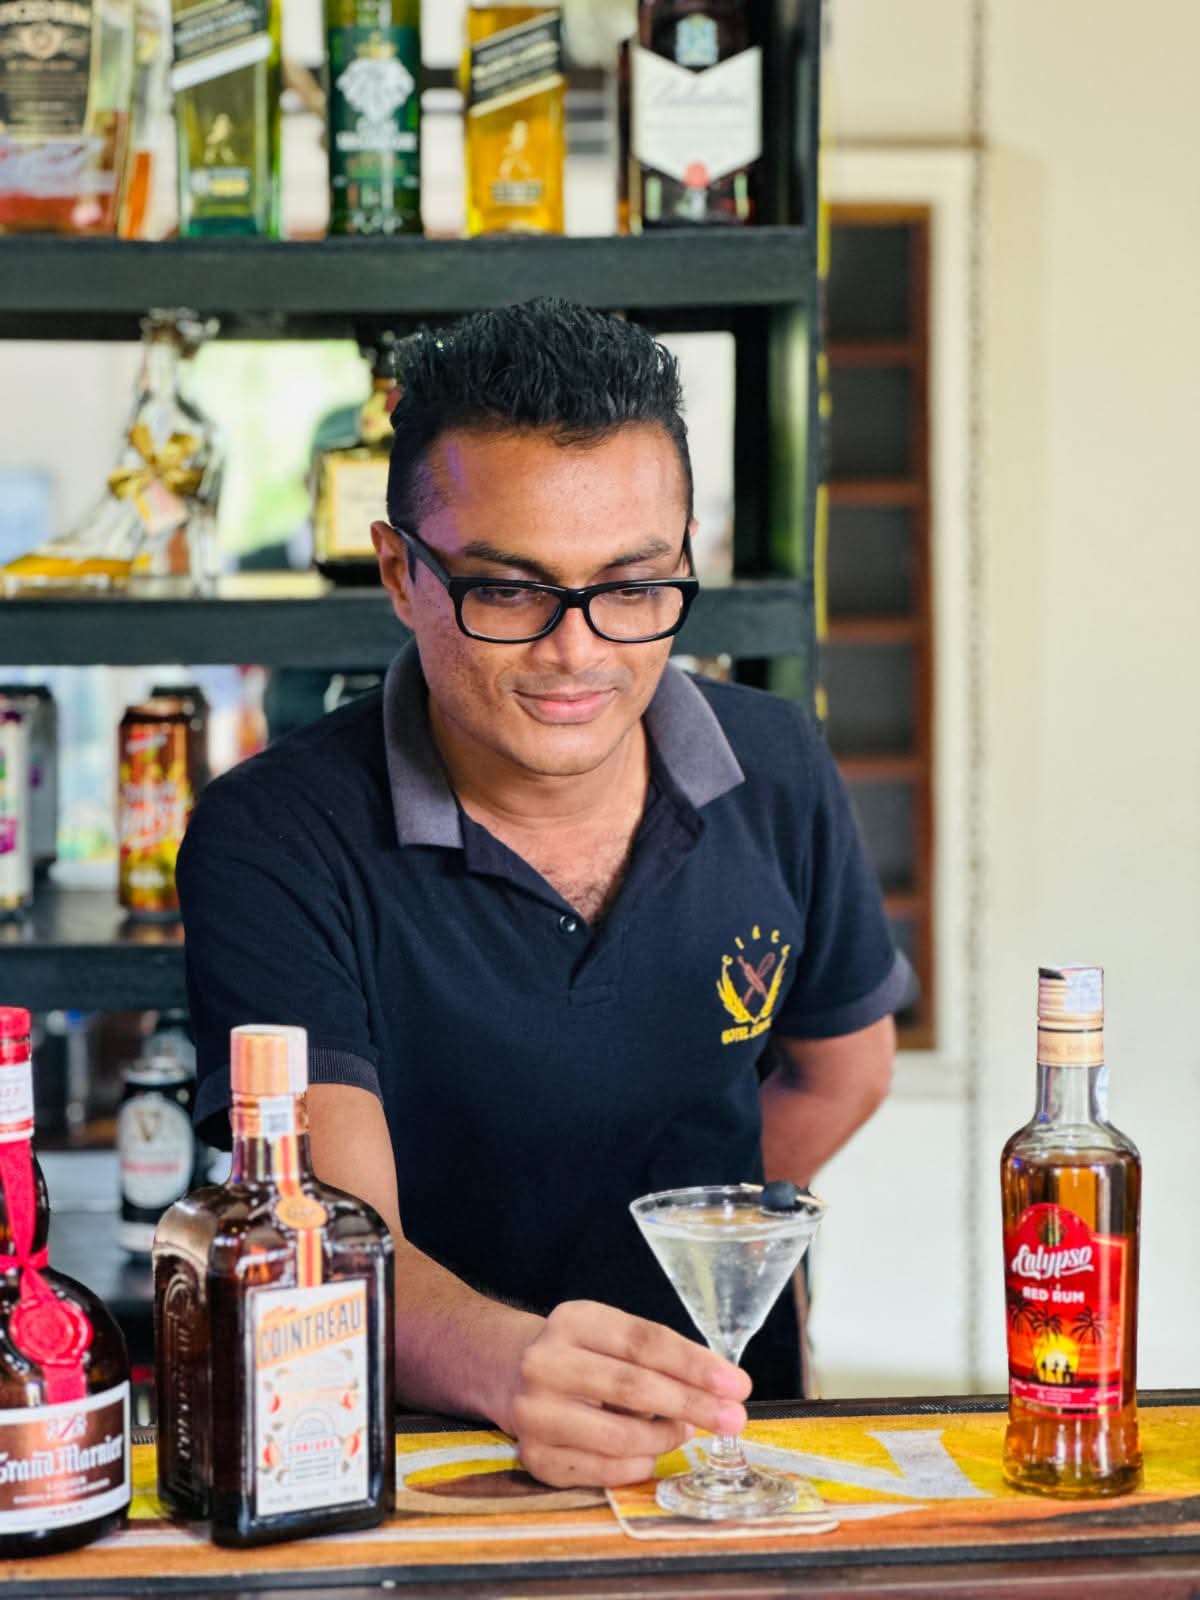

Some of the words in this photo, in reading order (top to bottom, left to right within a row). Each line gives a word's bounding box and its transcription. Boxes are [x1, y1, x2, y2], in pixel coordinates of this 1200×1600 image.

[1011, 1243, 1094, 1280] Calypso
[1022, 1286, 1049, 1301] RED
[1052, 1290, 1085, 1303] RUM
[259, 1298, 362, 1363] COINTREAU
